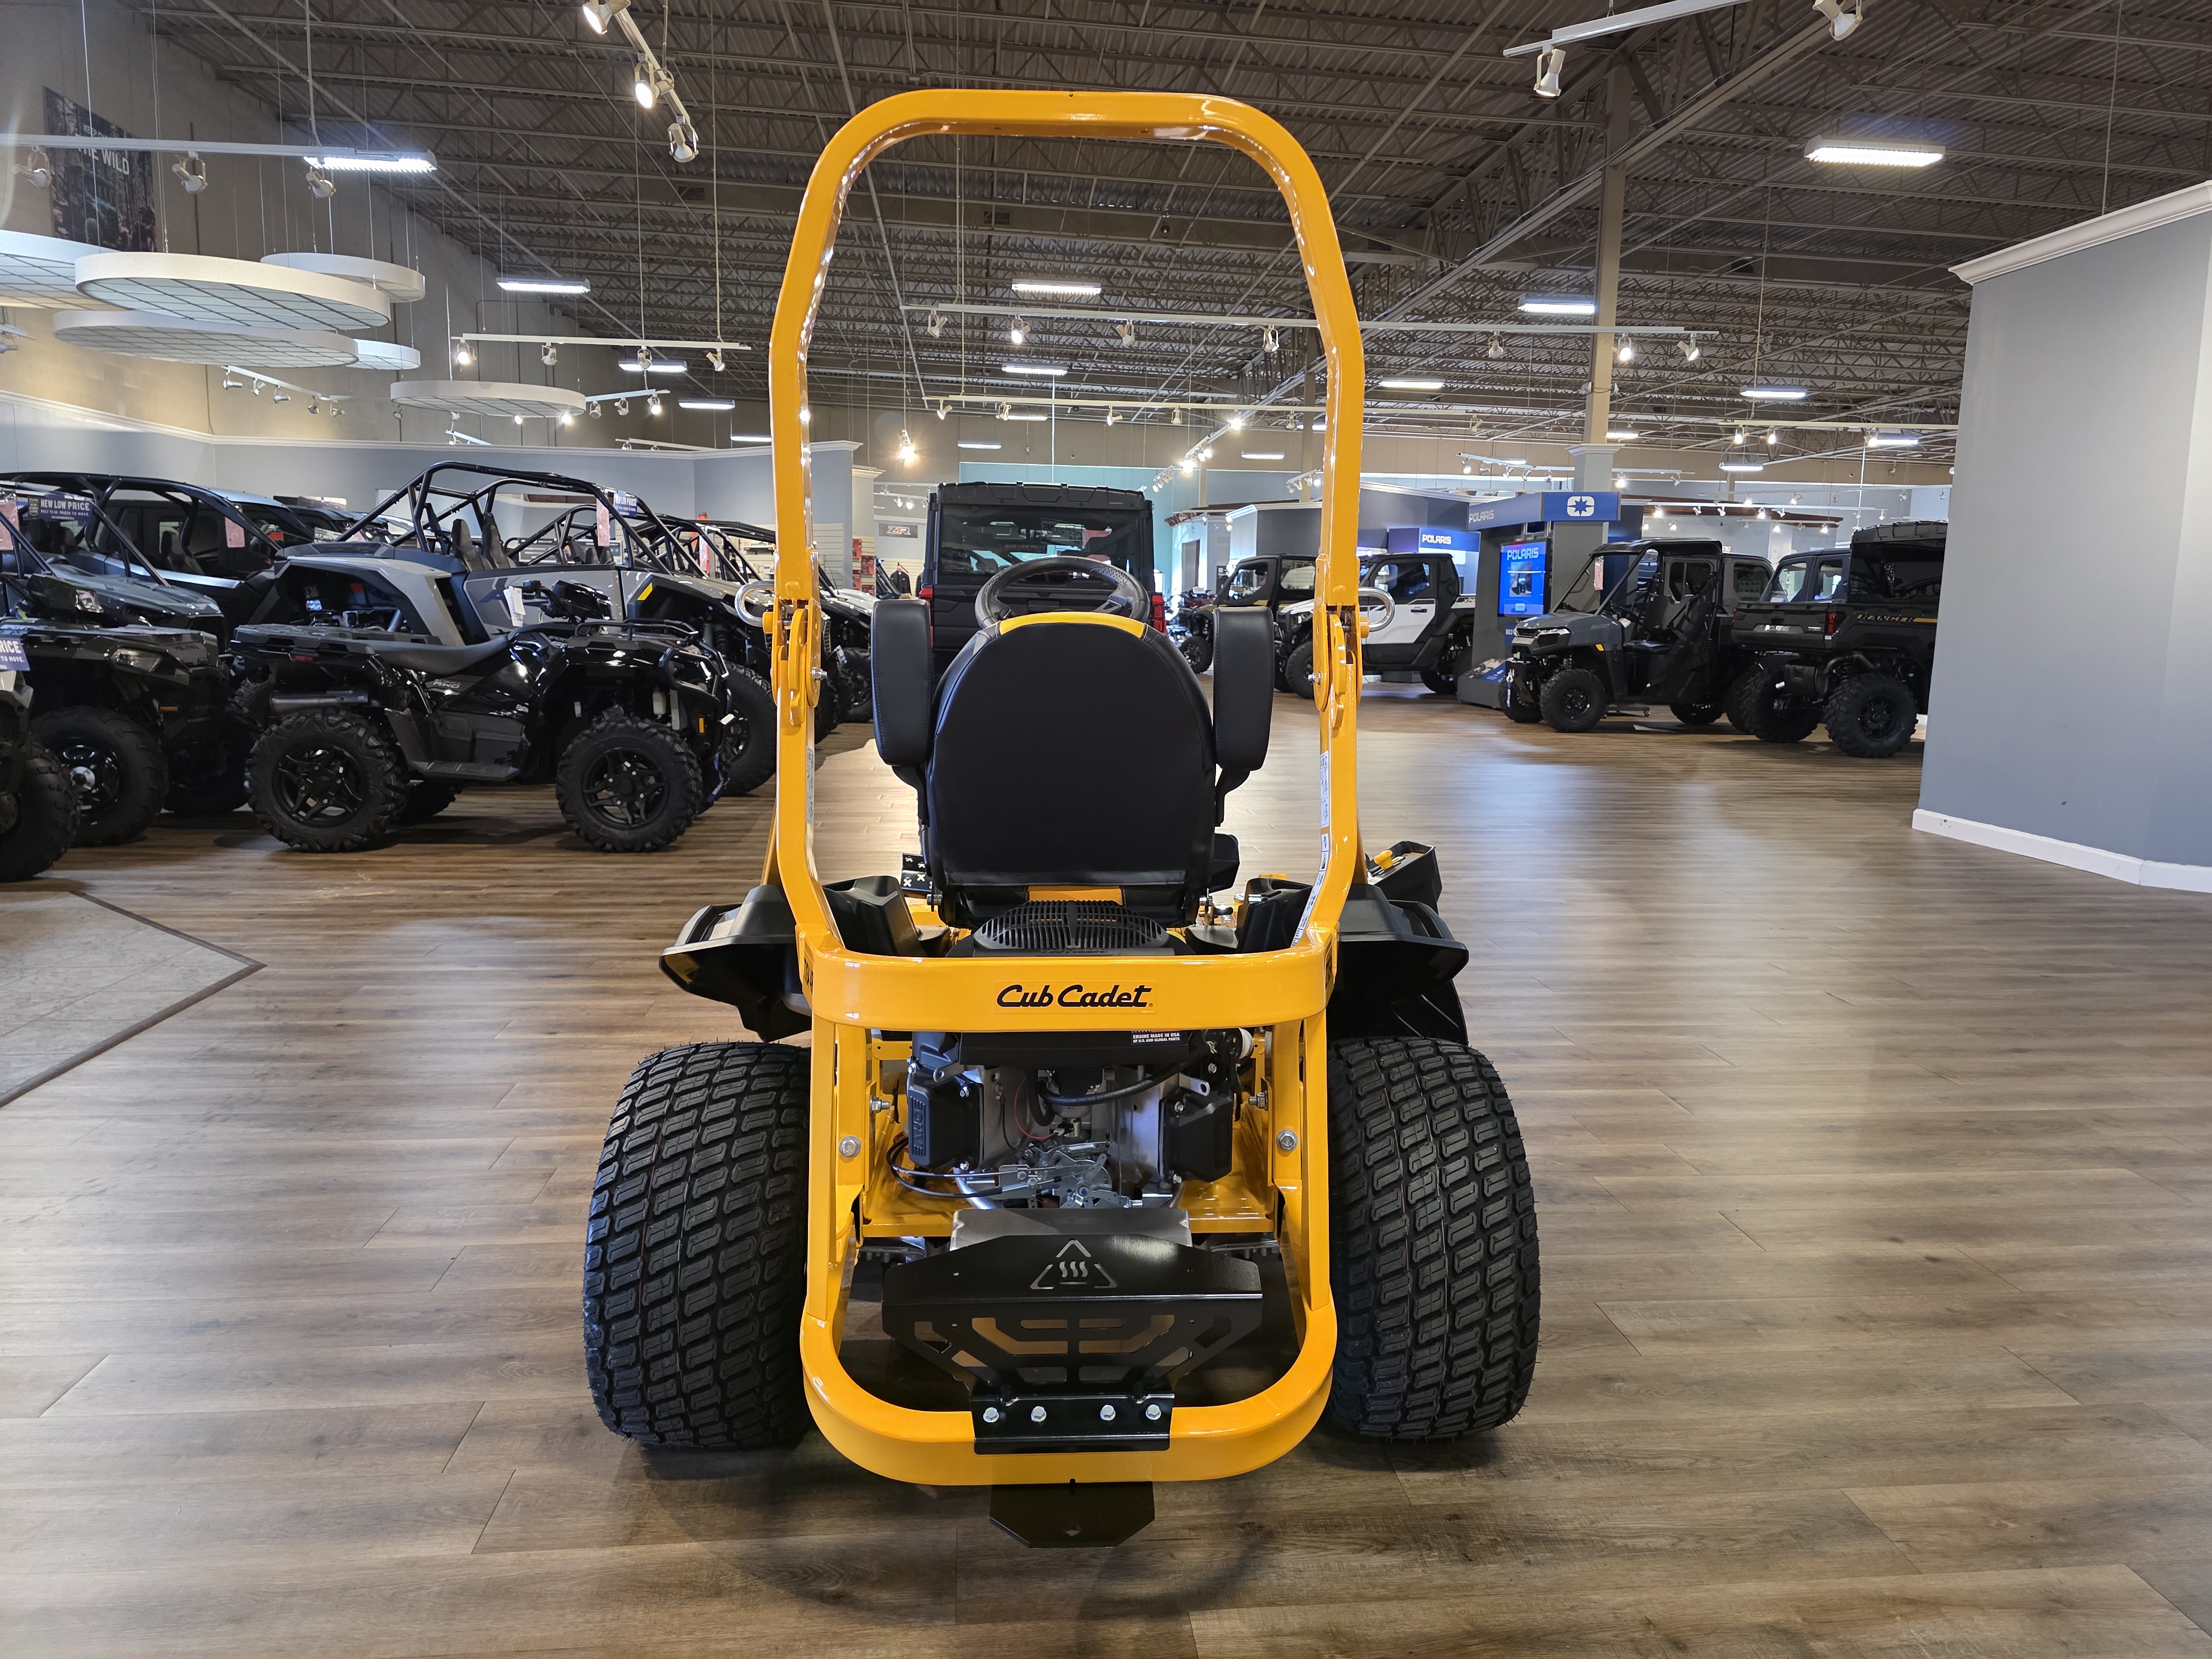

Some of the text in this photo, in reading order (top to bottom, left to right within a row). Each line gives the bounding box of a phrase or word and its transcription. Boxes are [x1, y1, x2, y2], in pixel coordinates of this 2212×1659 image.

[83, 123, 97, 137] KEEP
[78, 148, 129, 175] HE WILD
[40, 499, 53, 508] NEW
[54, 500, 66, 509] LOW
[67, 501, 90, 511] PRICE
[1469, 509, 1494, 523] POLARIS
[1422, 534, 1452, 545] POLARIS
[1506, 547, 1539, 561] POLARIS
[1856, 614, 1913, 622] RANGER
[433, 681, 460, 689] AWD
[996, 984, 1152, 1008] Cub Cadet
[913, 1109, 924, 1146] OHV
